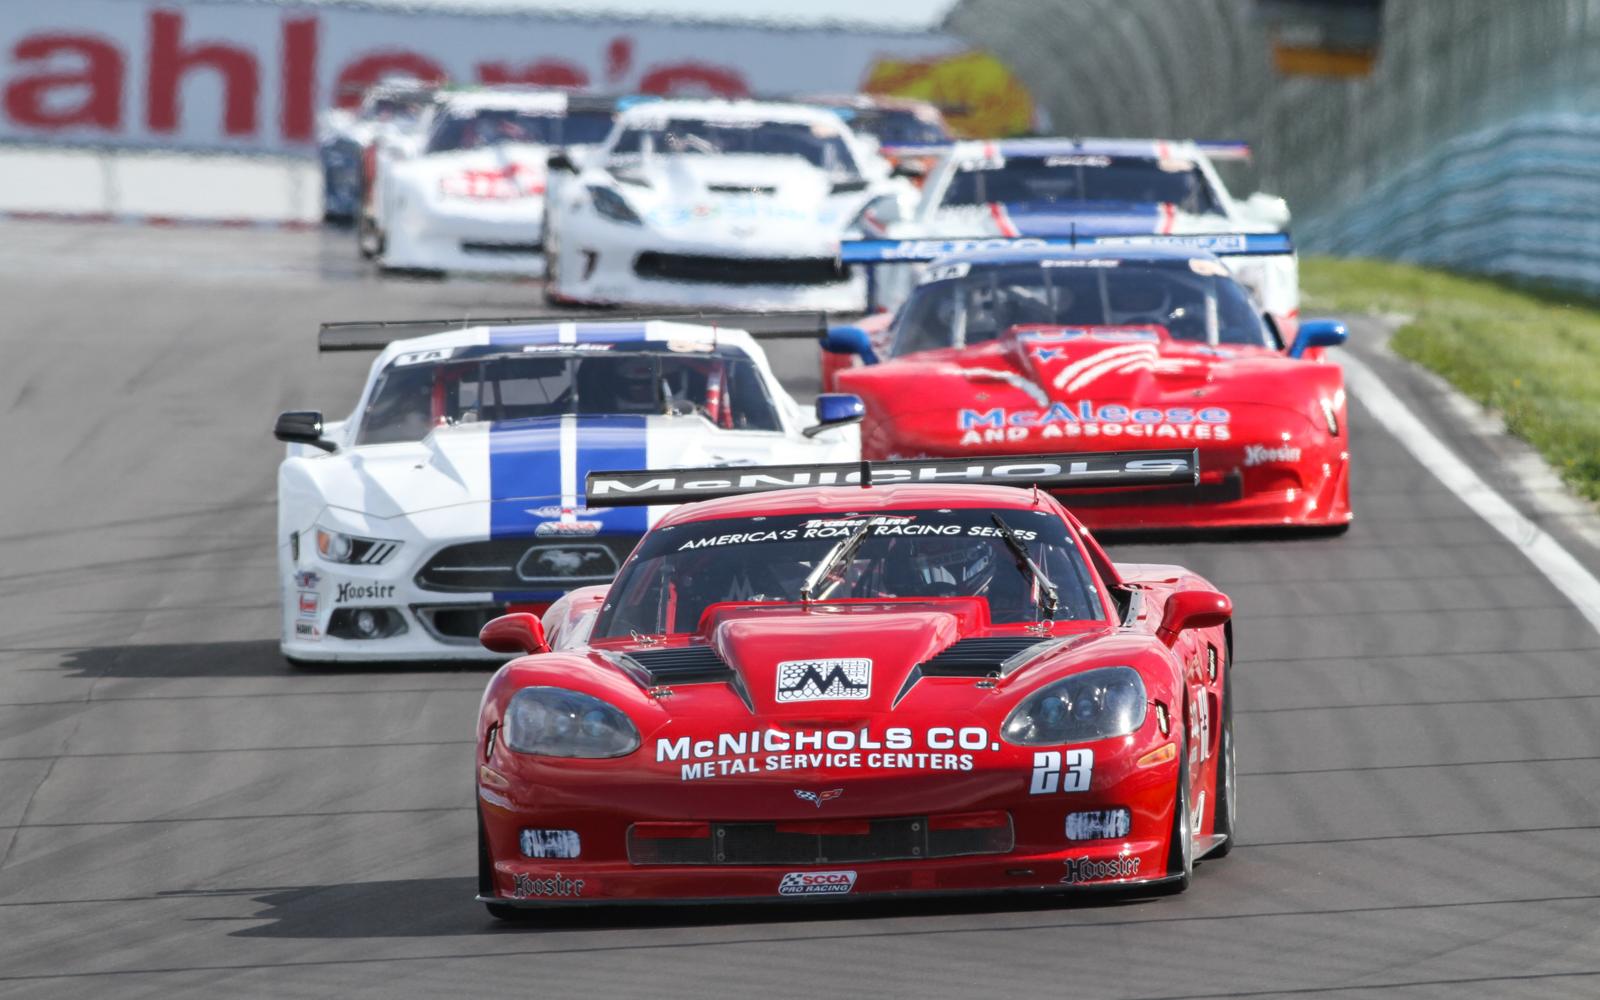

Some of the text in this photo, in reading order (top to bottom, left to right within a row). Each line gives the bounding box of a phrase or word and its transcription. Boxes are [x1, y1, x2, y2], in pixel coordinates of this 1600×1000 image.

[958, 400, 1231, 428] McAleese
[960, 423, 1231, 446] AND ASSOCIATES
[591, 457, 1190, 495] McNICHOLS
[678, 525, 1038, 551] AMERICA'S ROA RACING SERES
[335, 580, 396, 603] Hoosier
[656, 727, 1000, 763] McNICHOLS CO.
[681, 753, 973, 781] METAL SERVICE CENTERS
[1029, 748, 1094, 795] 23
[801, 874, 850, 885] SCCA
[1060, 852, 1141, 884] Hoosier
[512, 872, 585, 900] Hoosier
